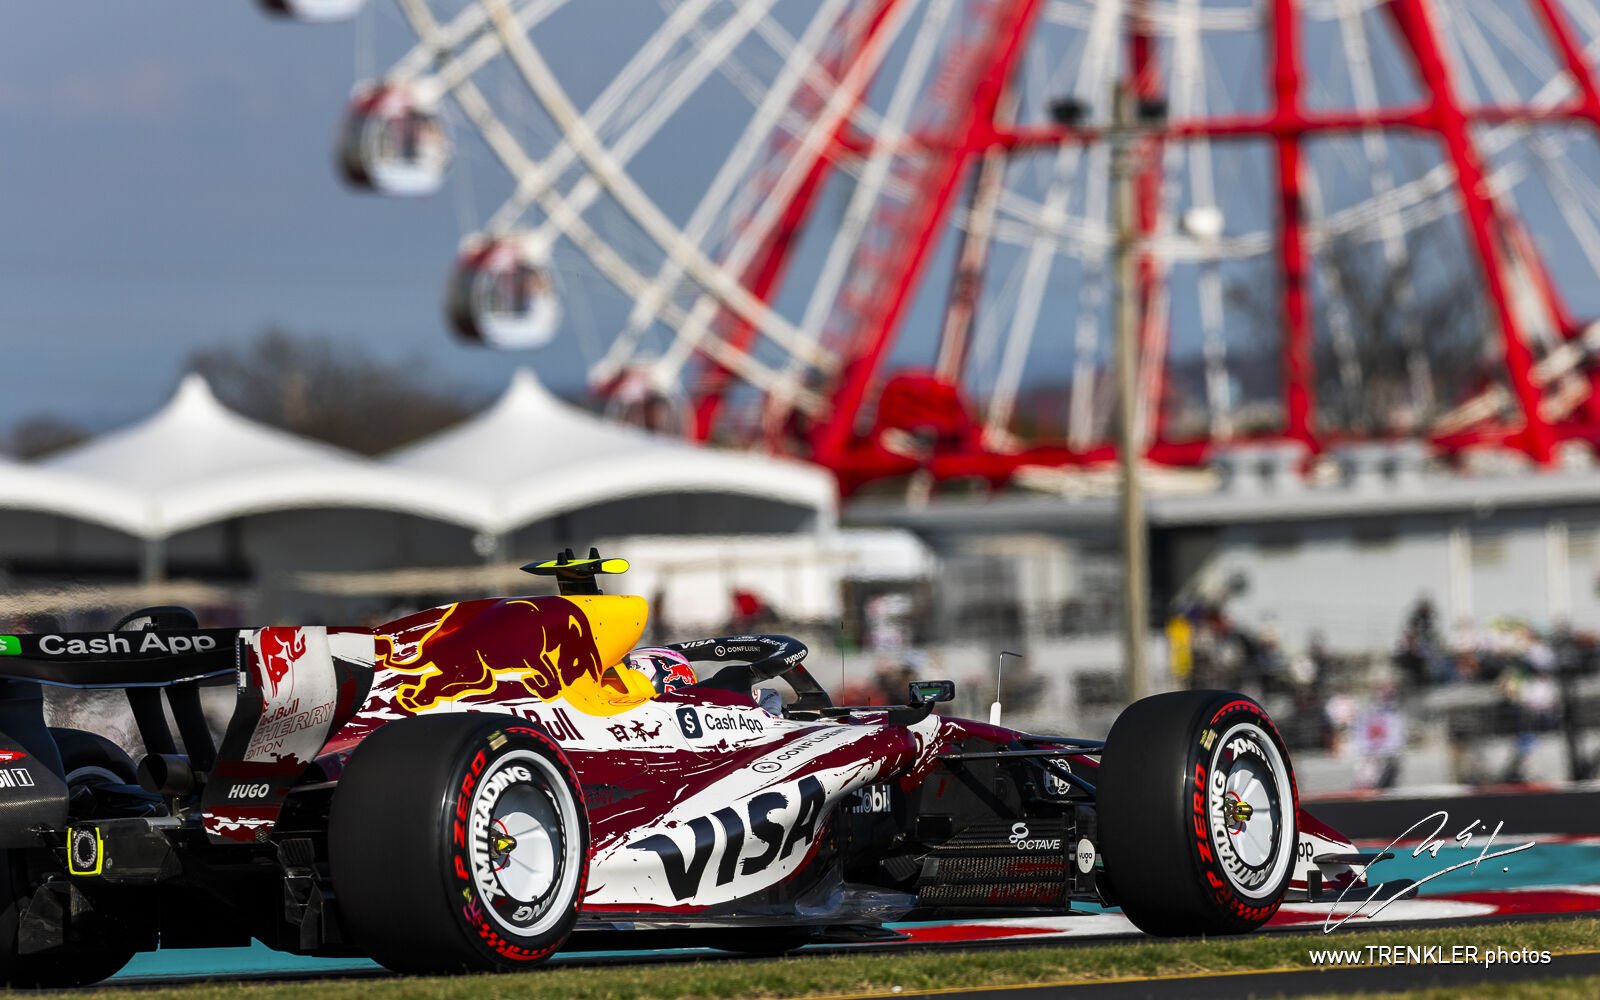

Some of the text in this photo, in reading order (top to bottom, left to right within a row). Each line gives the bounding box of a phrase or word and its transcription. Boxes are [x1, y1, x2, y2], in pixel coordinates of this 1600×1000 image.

[39, 633, 131, 655] Cash
[139, 632, 217, 655] App
[680, 639, 716, 649] VISA
[275, 698, 300, 720] Bull
[704, 713, 738, 731] Cash
[739, 713, 764, 734] App
[228, 783, 270, 799] HUGO
[453, 747, 488, 849] ZERO
[852, 785, 891, 814] Mobil
[1193, 763, 1214, 864] ZERO
[473, 766, 532, 902] XMTRADING
[625, 774, 826, 902] VISA
[1017, 839, 1061, 850] OCTAVE
